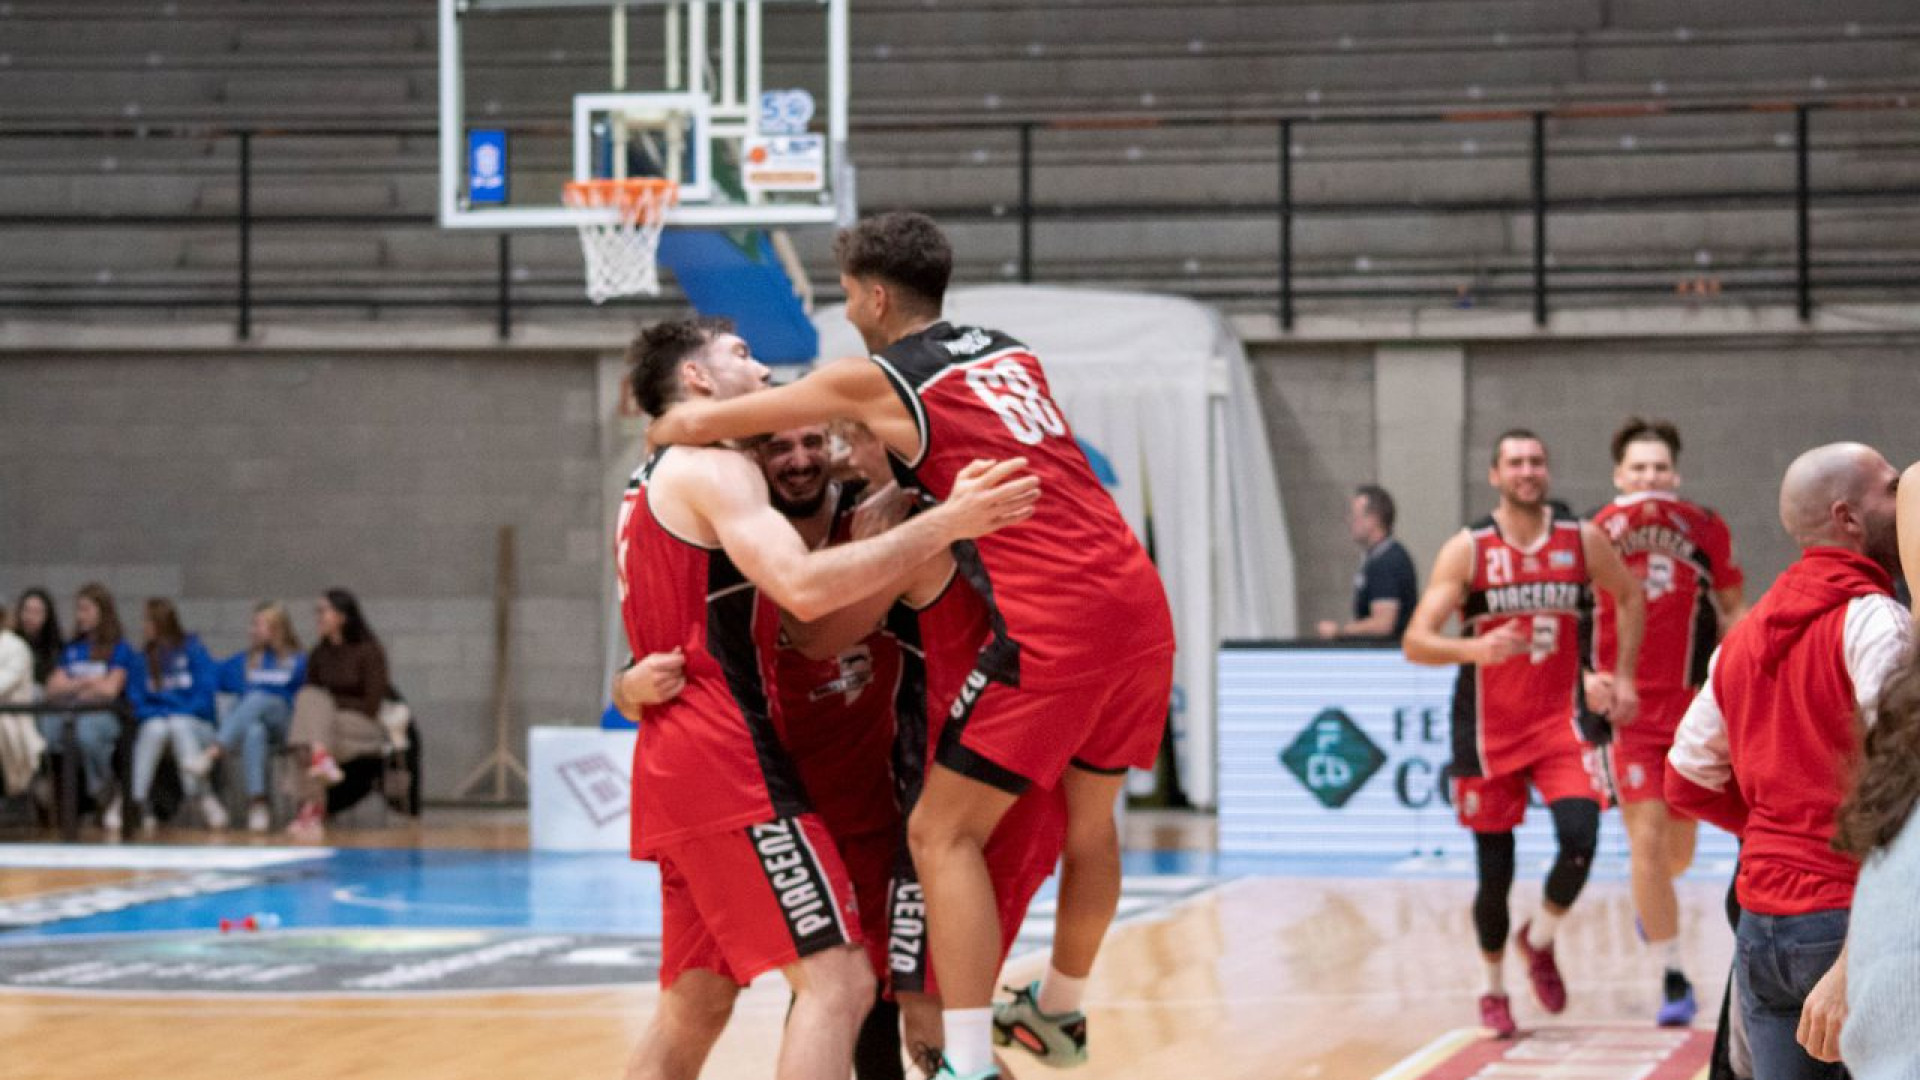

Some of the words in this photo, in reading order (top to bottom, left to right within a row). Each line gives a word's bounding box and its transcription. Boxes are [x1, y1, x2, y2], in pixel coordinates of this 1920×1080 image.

[1485, 547, 1513, 583] 21
[1485, 583, 1577, 612] PIACENZA
[1395, 706, 1443, 743] FE
[890, 880, 926, 973] CENZA
